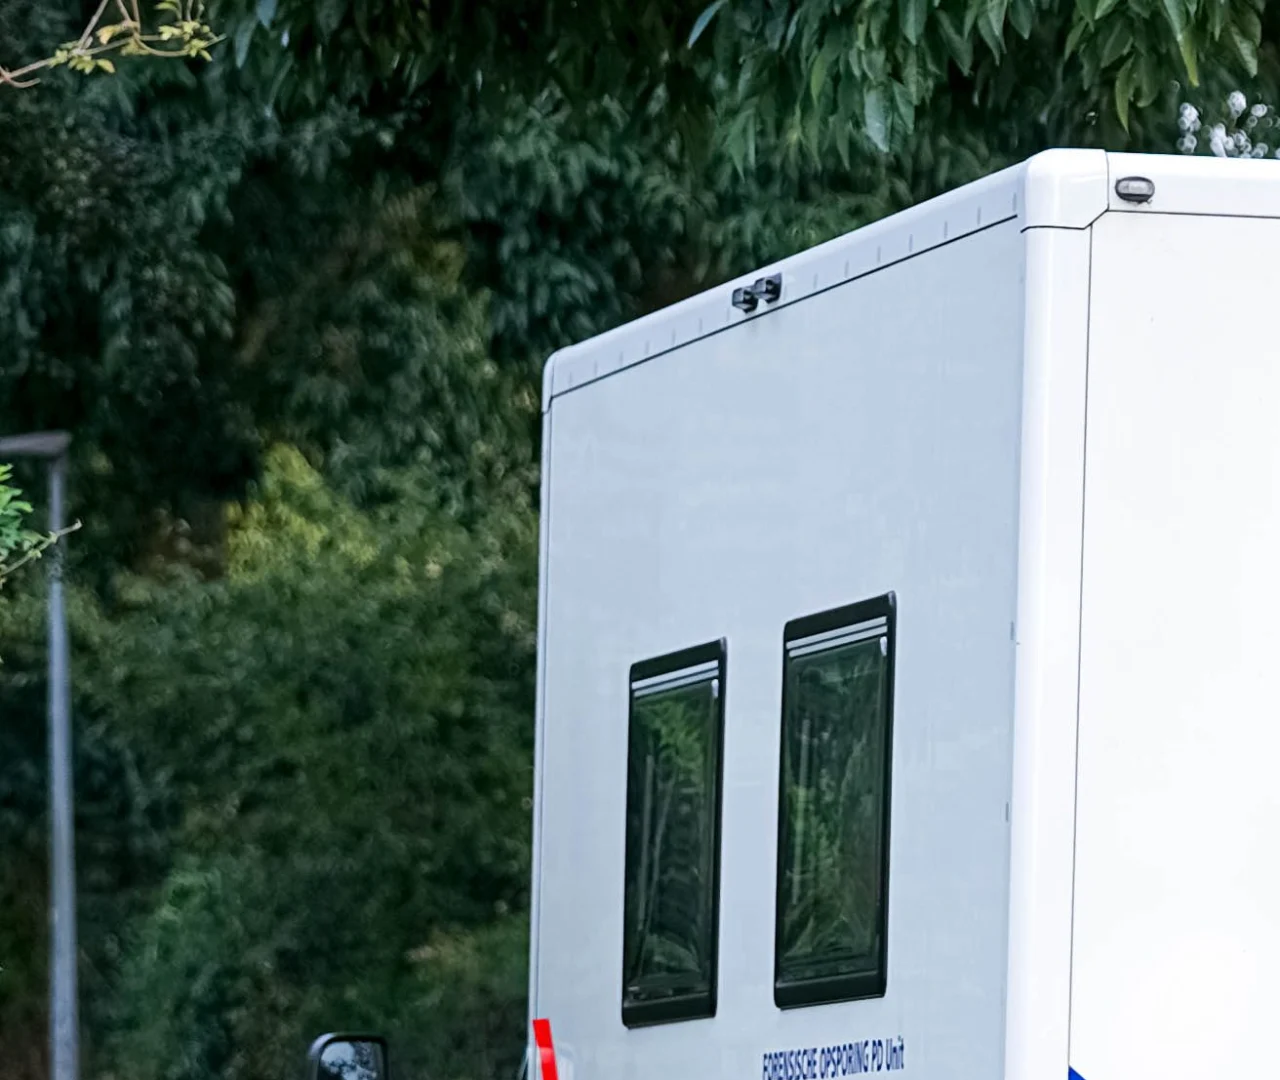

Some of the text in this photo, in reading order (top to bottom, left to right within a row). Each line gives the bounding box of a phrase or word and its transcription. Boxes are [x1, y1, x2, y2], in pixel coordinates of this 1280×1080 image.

[820, 1040, 869, 1079] OPSPORING
[871, 1039, 884, 1072] PD
[886, 1035, 905, 1071] Unit
